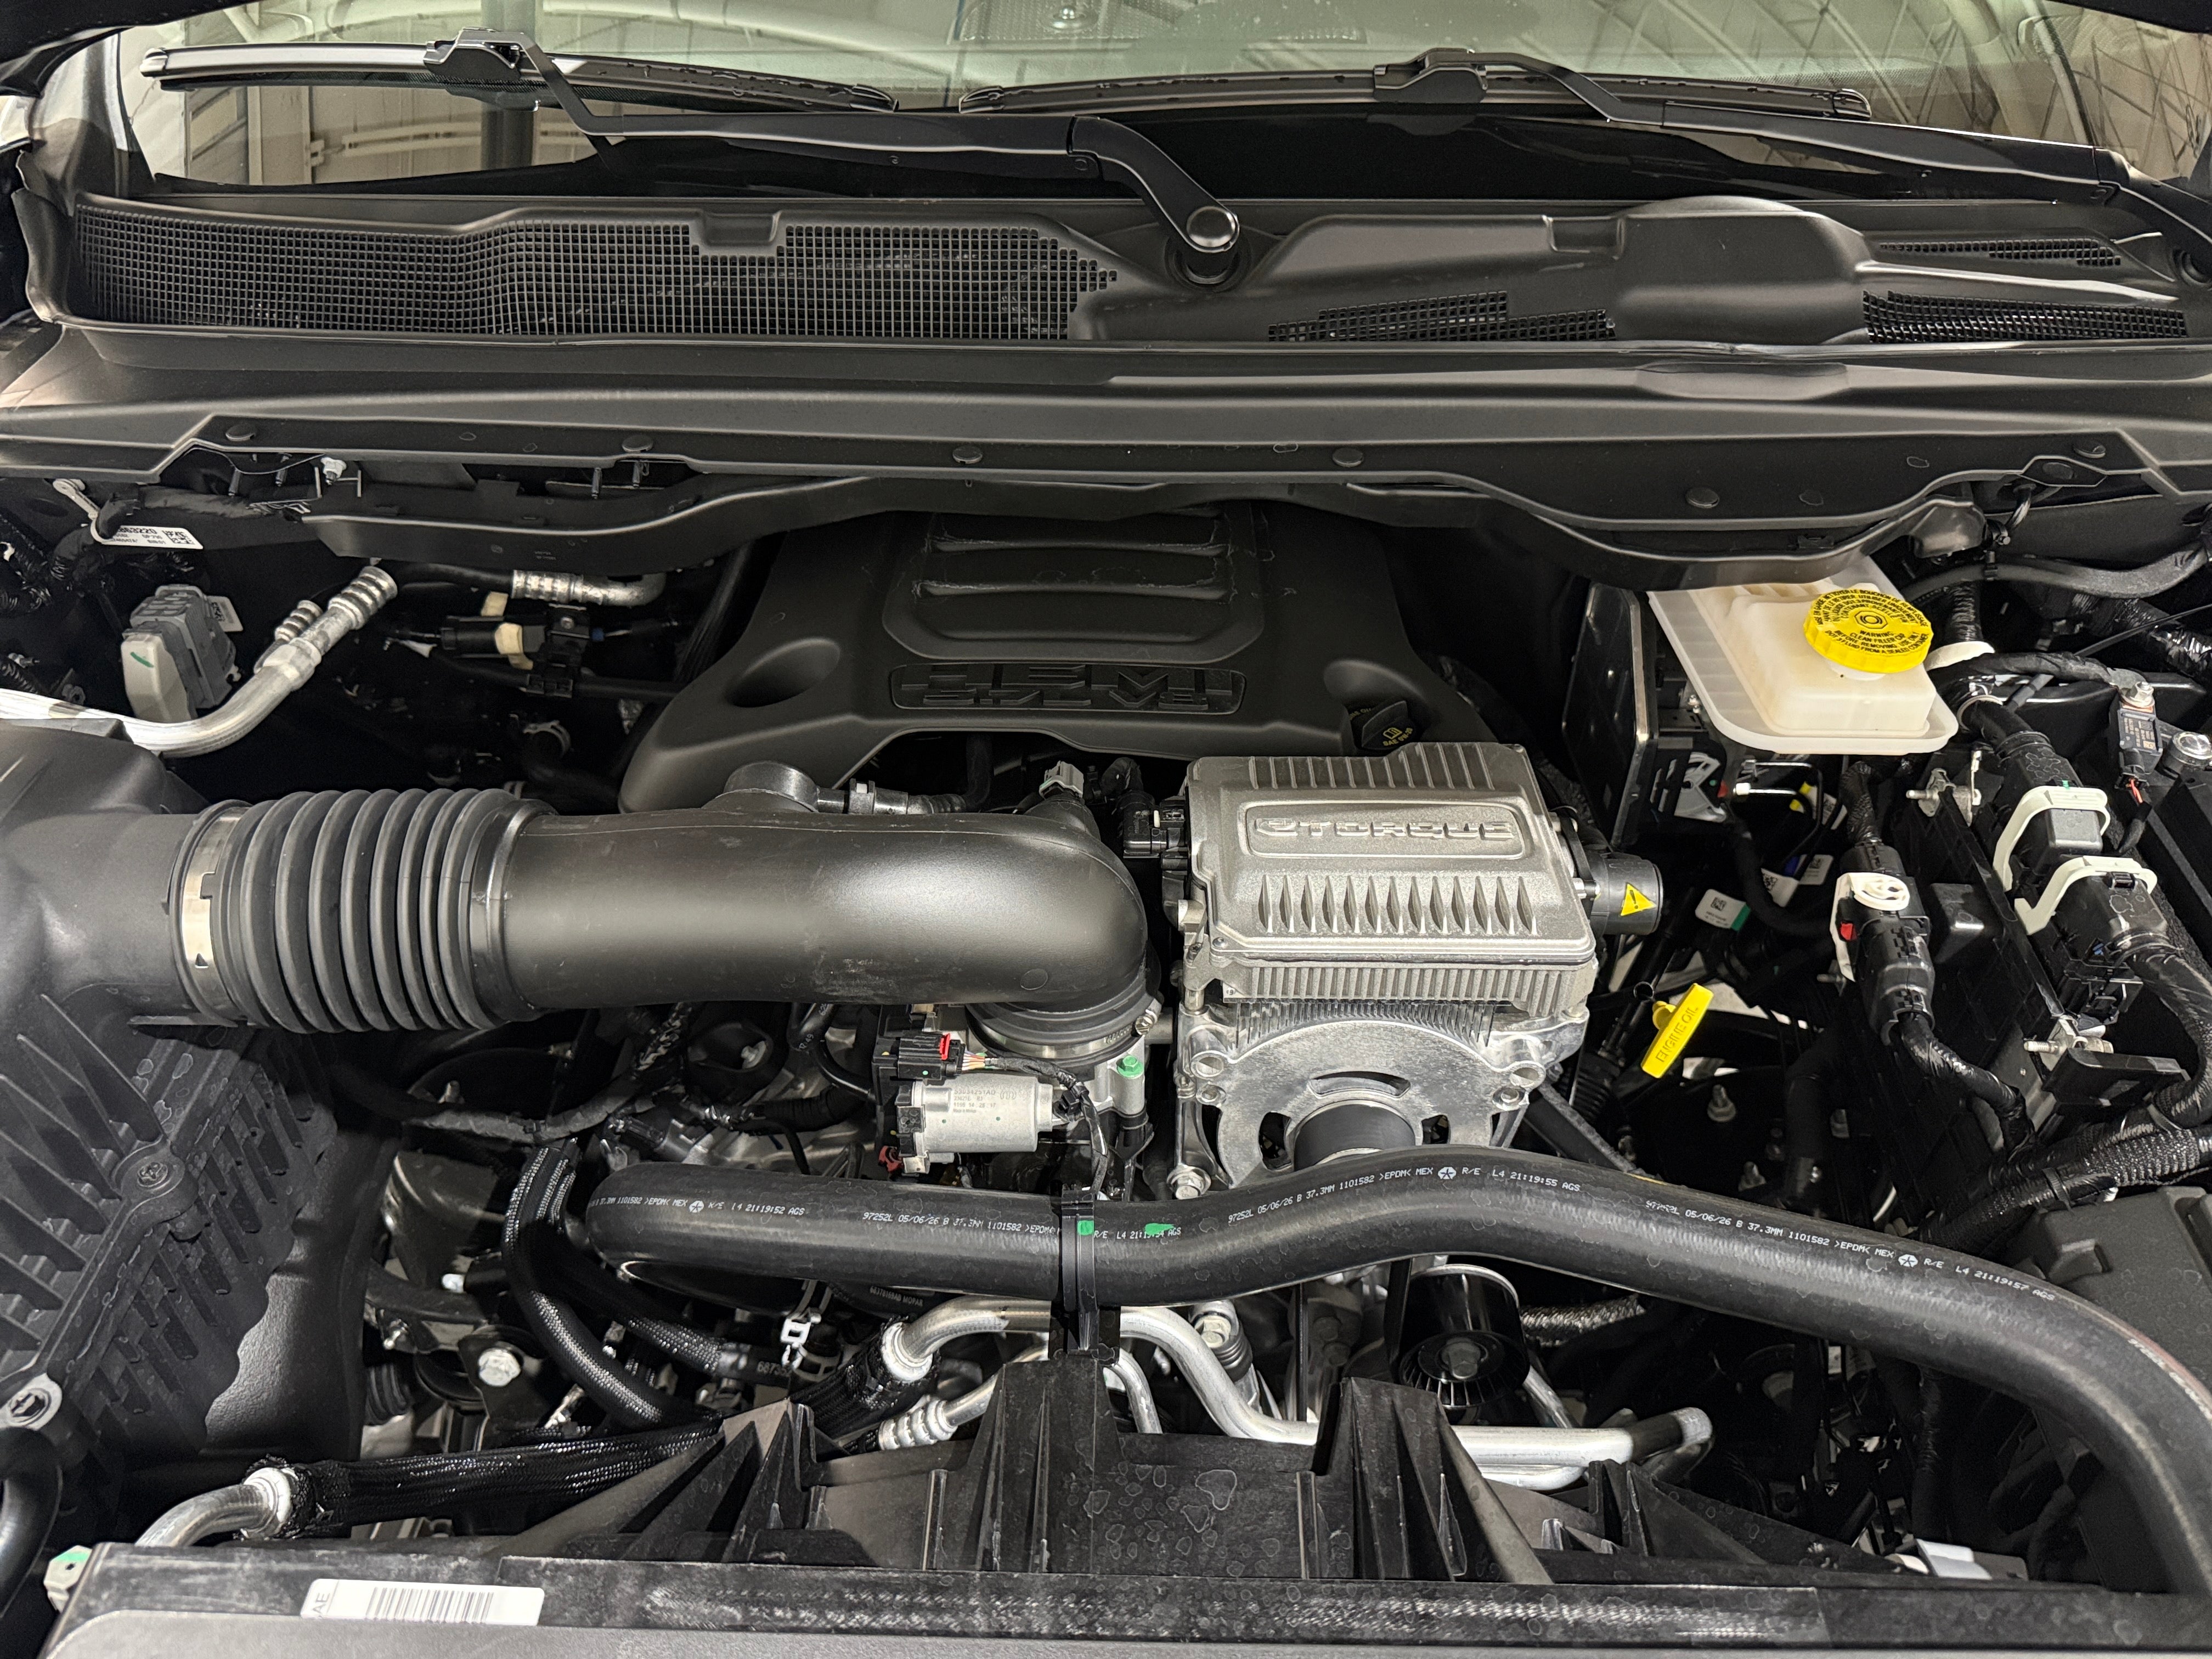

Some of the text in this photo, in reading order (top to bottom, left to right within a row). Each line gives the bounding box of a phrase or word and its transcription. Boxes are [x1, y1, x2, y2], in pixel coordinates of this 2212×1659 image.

[1834, 630, 1859, 644] BEFORE
[1899, 639, 1911, 647] USE
[1840, 639, 1860, 649] FLUID
[1850, 632, 1872, 642] CLEAN
[1108, 691, 1209, 710] V8
[1383, 738, 1398, 747] SAE
[1656, 1007, 1699, 1063] ENGINE OIL
[1228, 1209, 1254, 1224] 97252L
[1257, 1195, 1294, 1215] 05/06/26
[1306, 1184, 1336, 1199] 37.3MM
[1339, 1175, 1375, 1190] 1101582
[1379, 1169, 1412, 1182] >EPDM<
[1415, 1167, 1434, 1176] MEX
[1461, 1167, 1482, 1175] R/E
[1491, 1168, 1505, 1177] L4
[1510, 1171, 1558, 1187] 21:19:55
[1561, 1181, 1582, 1192] AGS
[617, 1197, 642, 1205] 1101582
[644, 1197, 671, 1206] >EPDM<
[672, 1199, 689, 1207] MEX
[745, 1203, 786, 1215] 21:19:52
[788, 1206, 806, 1216] AGS
[862, 1211, 894, 1222] 97252L
[898, 1214, 940, 1225] 05/06/26
[987, 1221, 1022, 1232] 1101582
[1116, 1231, 1126, 1240] L4
[1167, 1227, 1182, 1237] AGS
[1685, 1209, 1732, 1226] 05/06/26
[1735, 1220, 1743, 1228] B
[1747, 1222, 1784, 1237] 37.3MM
[1788, 1231, 1831, 1246] 1101582
[1834, 1240, 1871, 1254] >EPDM<
[1874, 1248, 1895, 1259] MEX
[1923, 1257, 1945, 1269] R/E
[1955, 1265, 1970, 1276] L4
[1973, 1269, 2030, 1290] 21:19:57
[2032, 1289, 2057, 1301] AGS
[902, 1295, 923, 1307] MOPAR
[314, 1592, 331, 1614] AE
